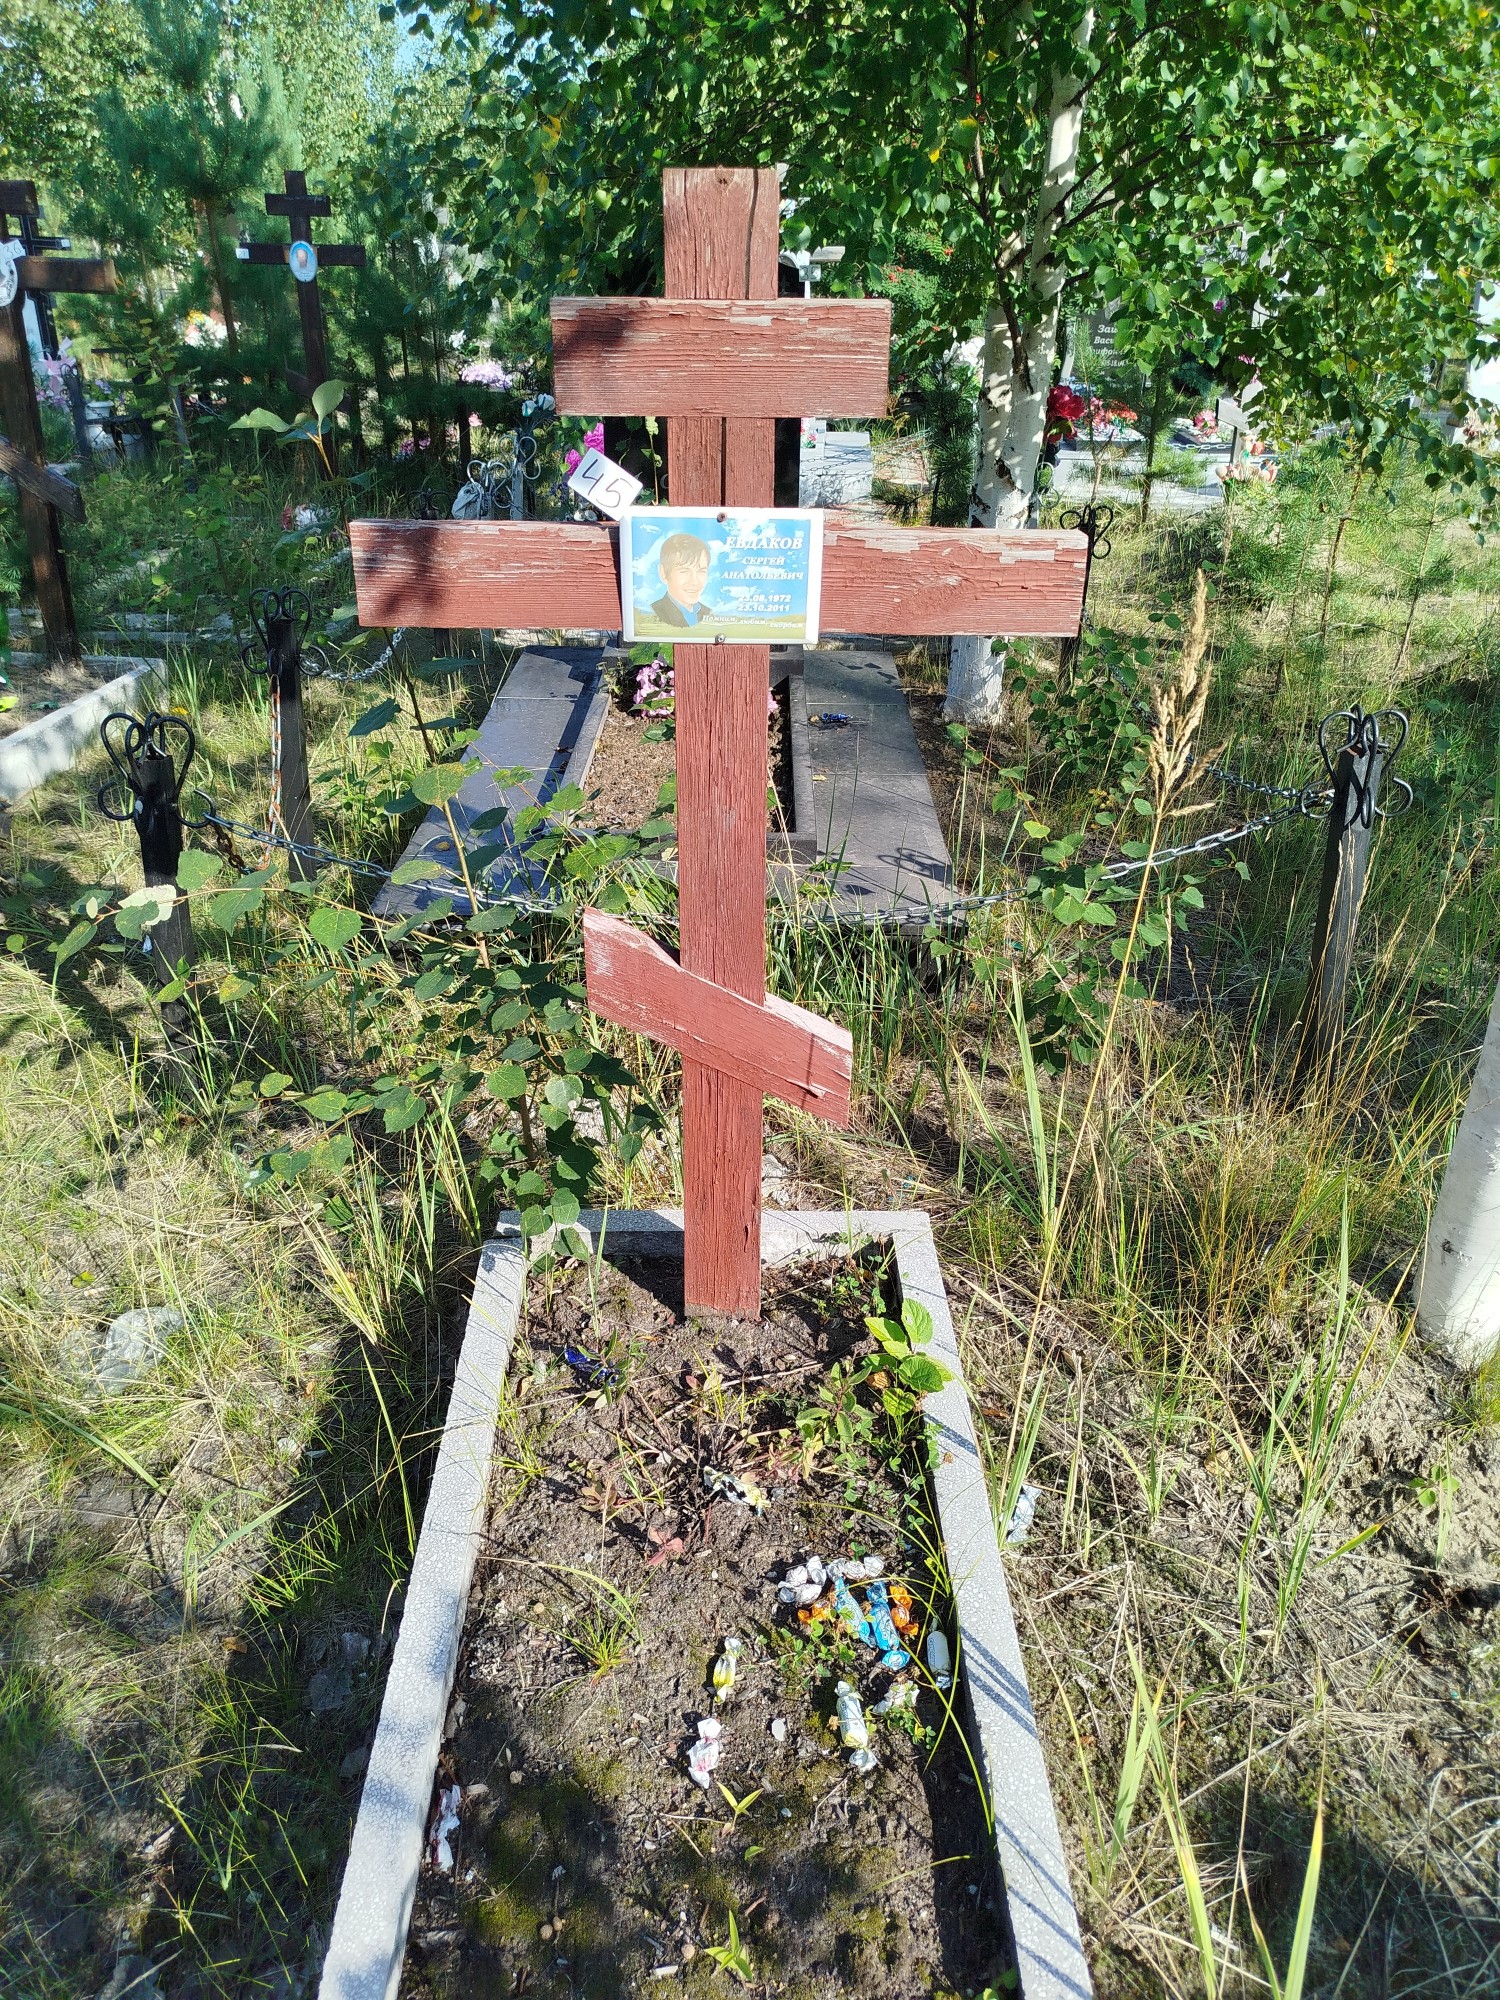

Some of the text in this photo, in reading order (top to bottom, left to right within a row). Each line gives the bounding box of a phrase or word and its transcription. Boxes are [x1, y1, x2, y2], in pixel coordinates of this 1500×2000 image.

[581, 458, 634, 509] 45
[725, 537, 803, 550] ЕВДАКОВ
[742, 556, 785, 566] СЕРГЕЙ
[721, 571, 804, 580] АНАТОЛЬЕВИЧ
[737, 604, 790, 612] 23.10.2011
[770, 621, 803, 629] скорбим
